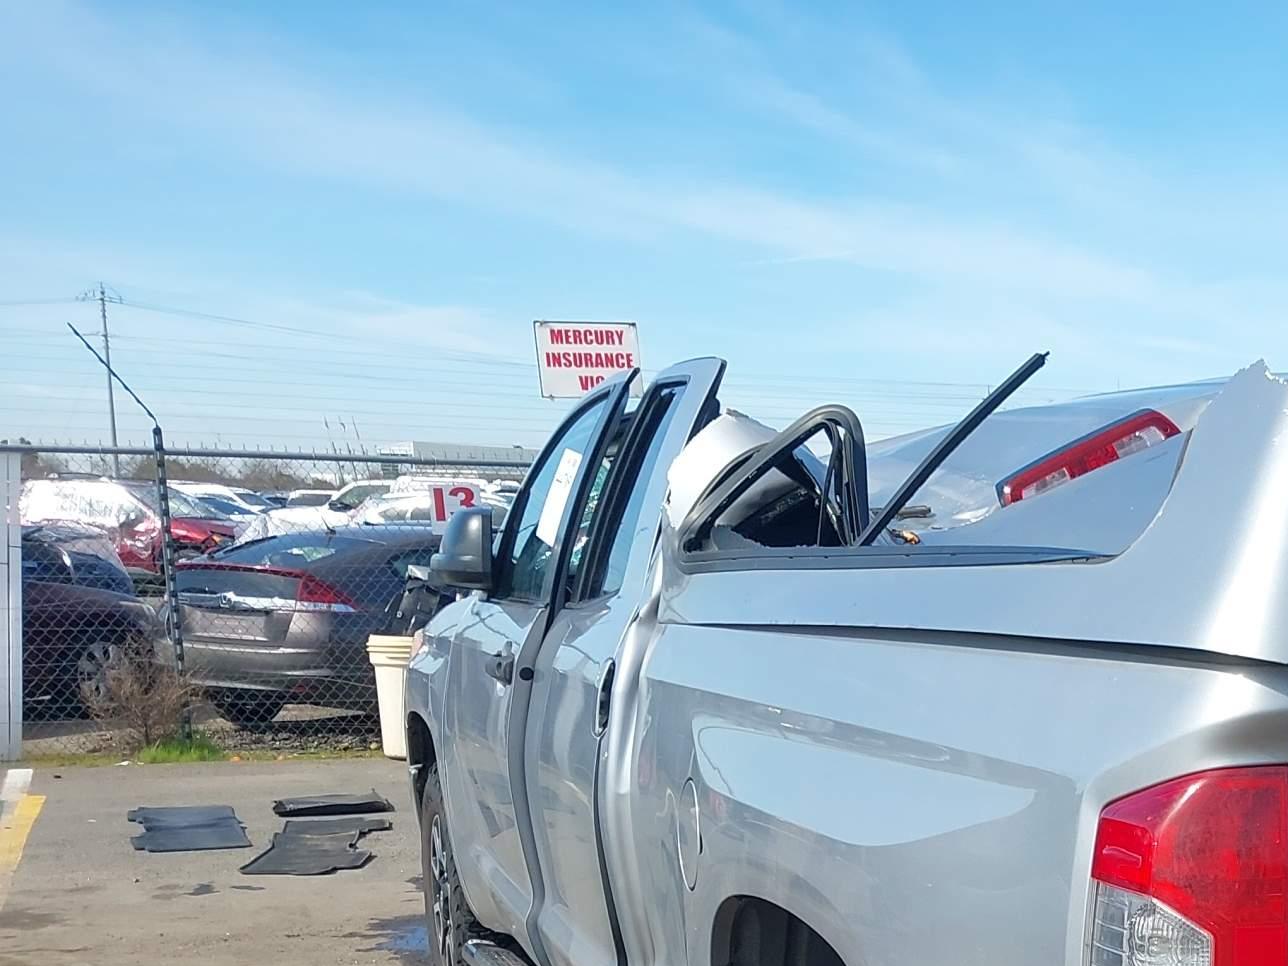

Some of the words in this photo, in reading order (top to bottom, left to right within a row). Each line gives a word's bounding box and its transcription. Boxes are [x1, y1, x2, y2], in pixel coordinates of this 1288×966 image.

[549, 328, 624, 346] MERCURY
[545, 351, 634, 369] INSURANCE
[432, 486, 476, 522] 13
